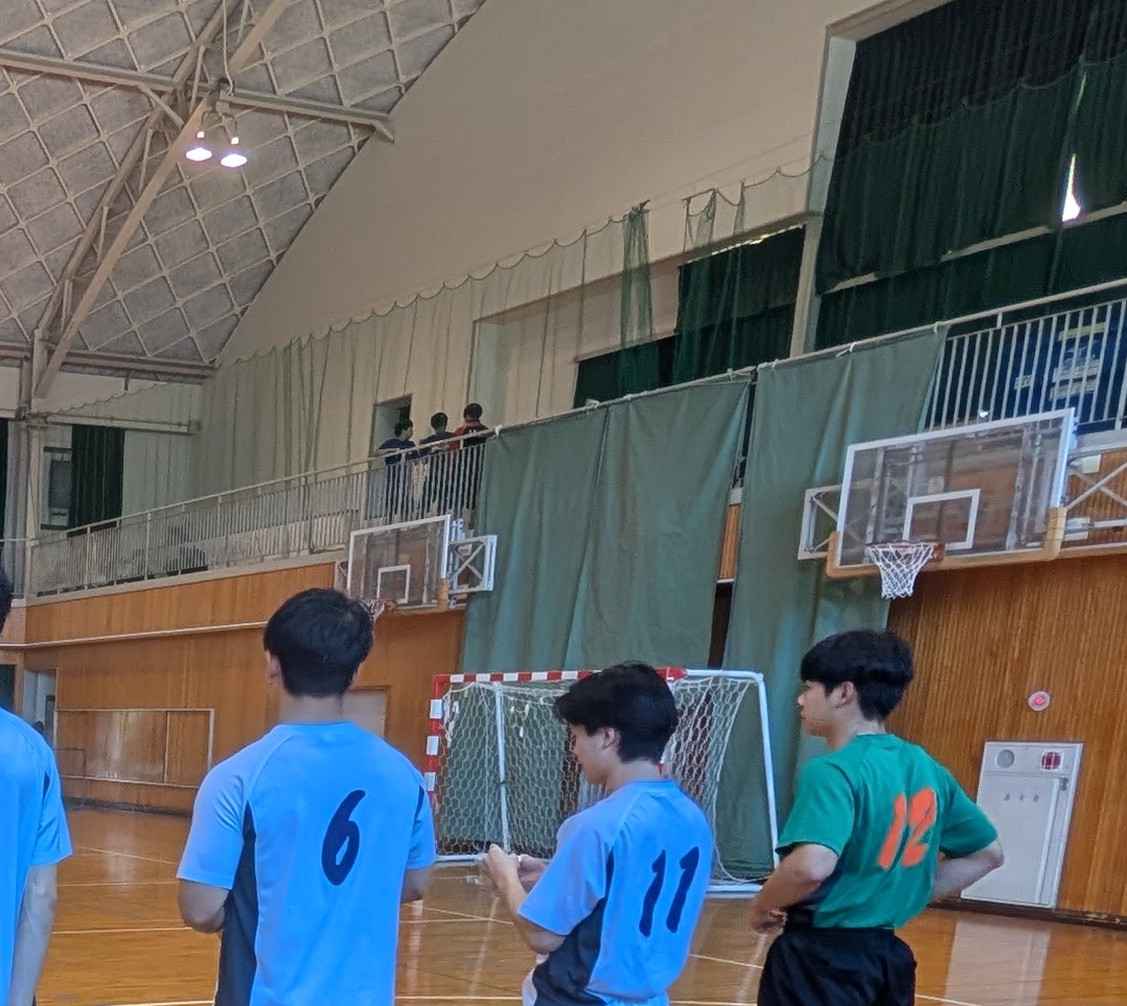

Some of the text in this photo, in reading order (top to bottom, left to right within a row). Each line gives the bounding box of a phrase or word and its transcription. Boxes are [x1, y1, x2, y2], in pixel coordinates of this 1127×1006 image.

[321, 790, 365, 886] 6
[879, 788, 937, 869] 12
[639, 846, 699, 937] 11
